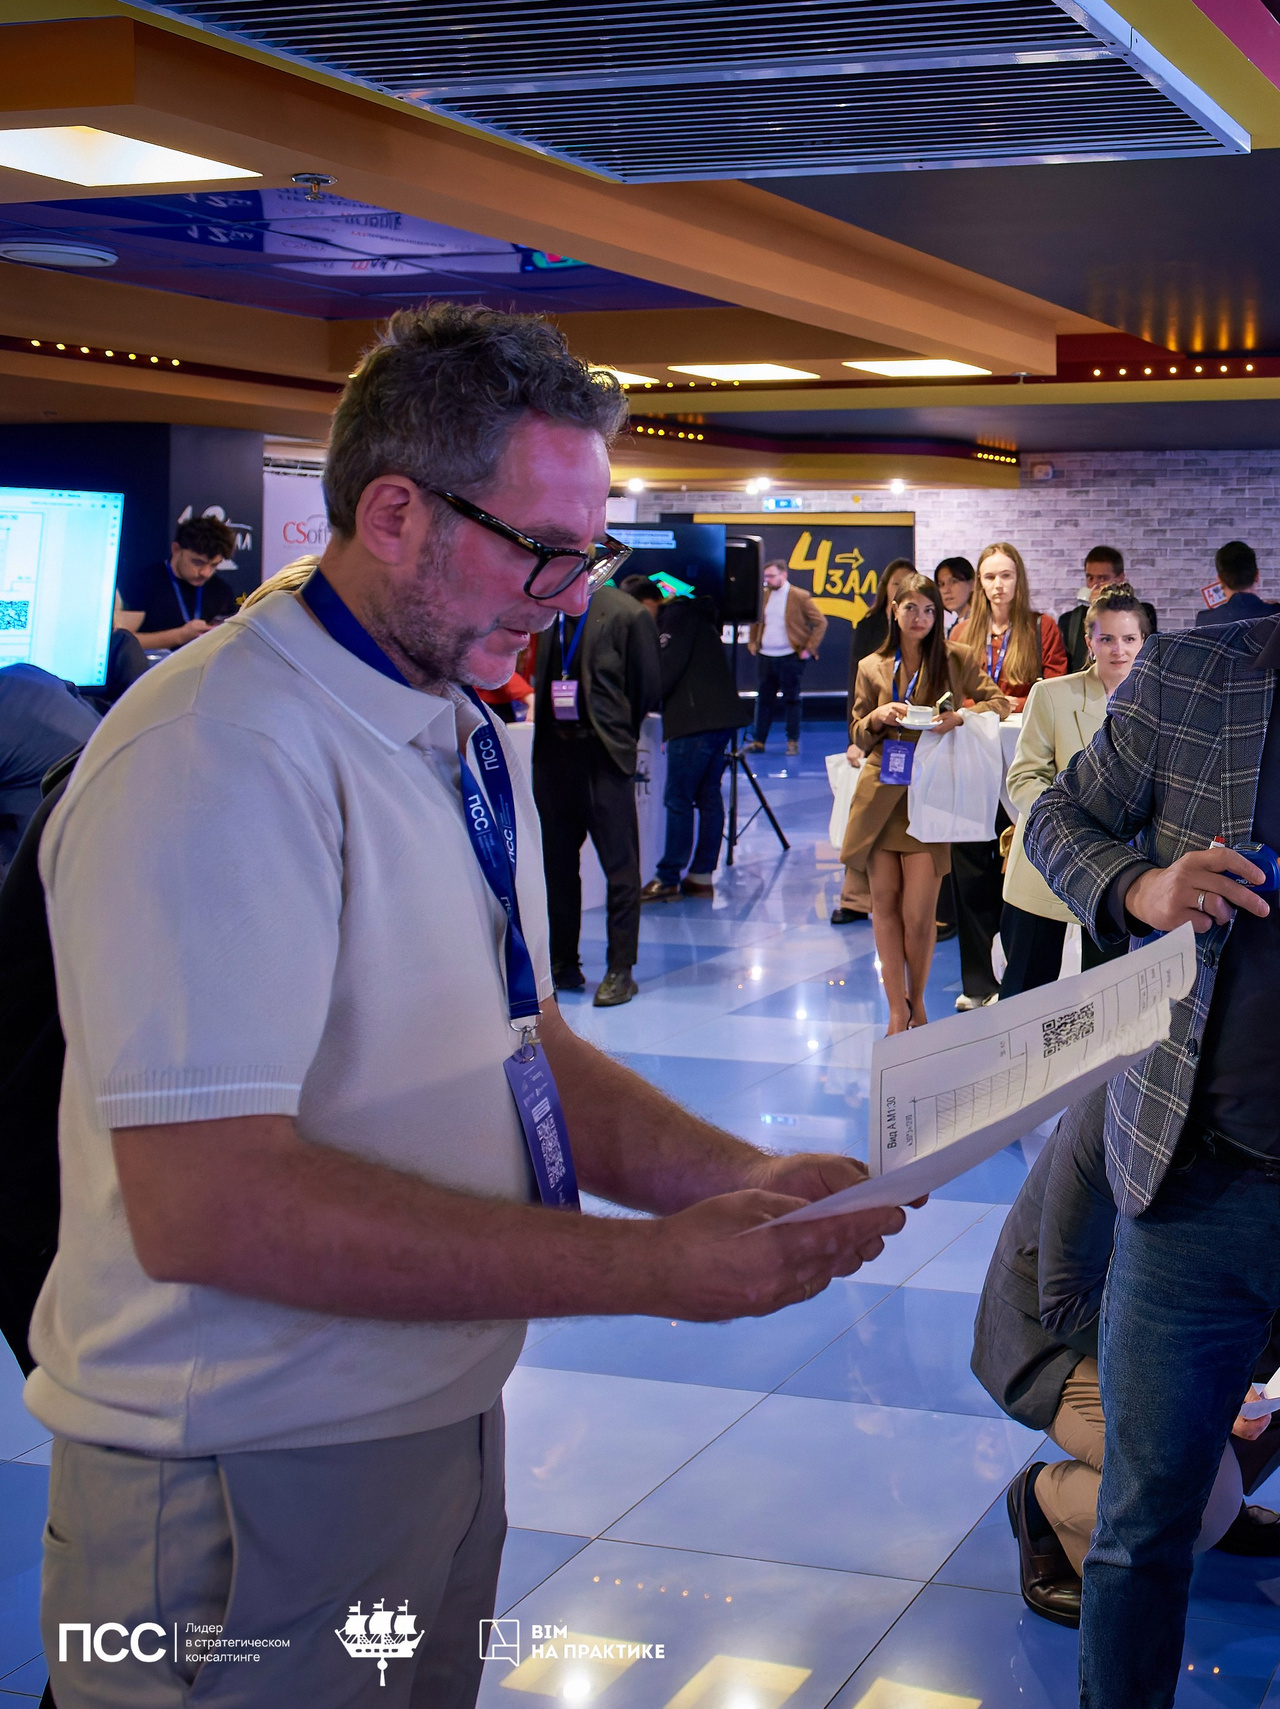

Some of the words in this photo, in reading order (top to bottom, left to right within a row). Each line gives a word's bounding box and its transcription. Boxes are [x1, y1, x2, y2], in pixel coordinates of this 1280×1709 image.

[788, 531, 833, 595] 4
[479, 738, 500, 771] ПСС
[468, 794, 489, 831] ПСС
[887, 1131, 898, 1149] Вид
